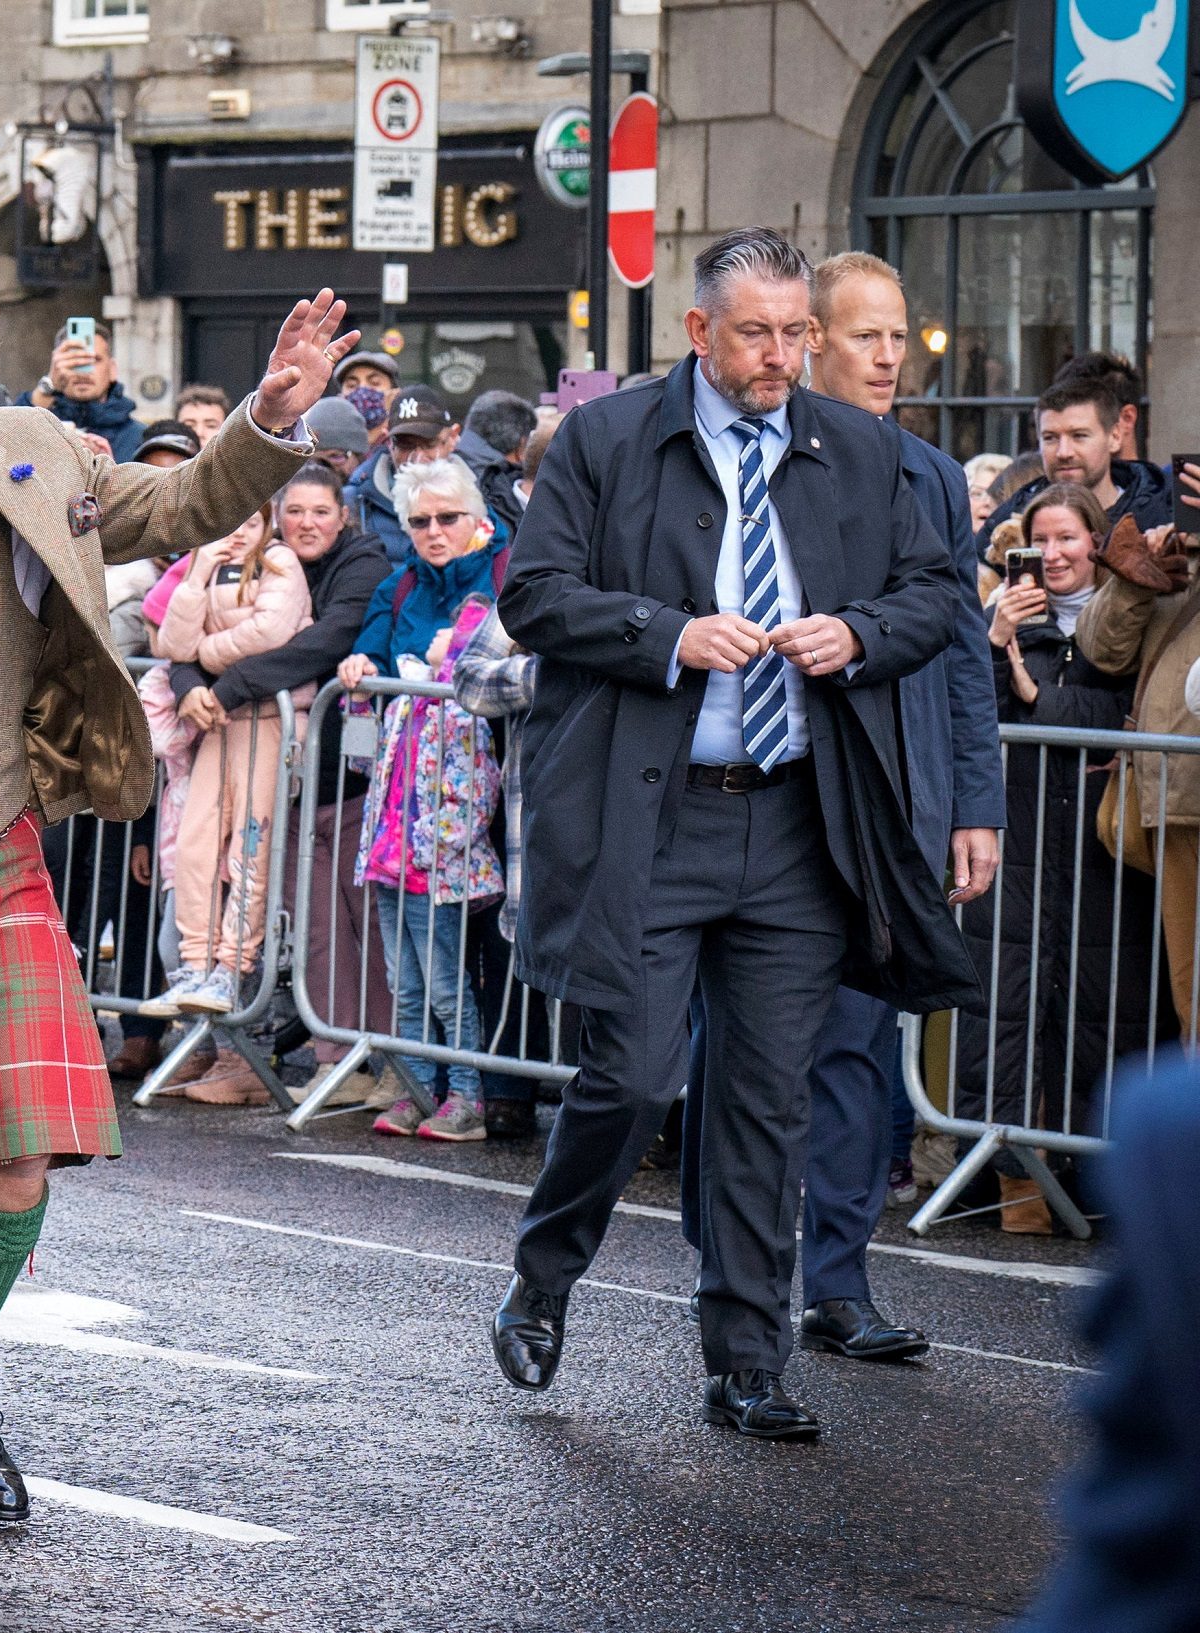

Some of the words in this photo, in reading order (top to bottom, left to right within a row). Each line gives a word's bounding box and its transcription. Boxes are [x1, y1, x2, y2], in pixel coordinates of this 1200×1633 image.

[373, 54, 422, 73] ZONE
[549, 150, 591, 168] Hein
[214, 184, 348, 250] THE
[399, 397, 418, 418] NY
